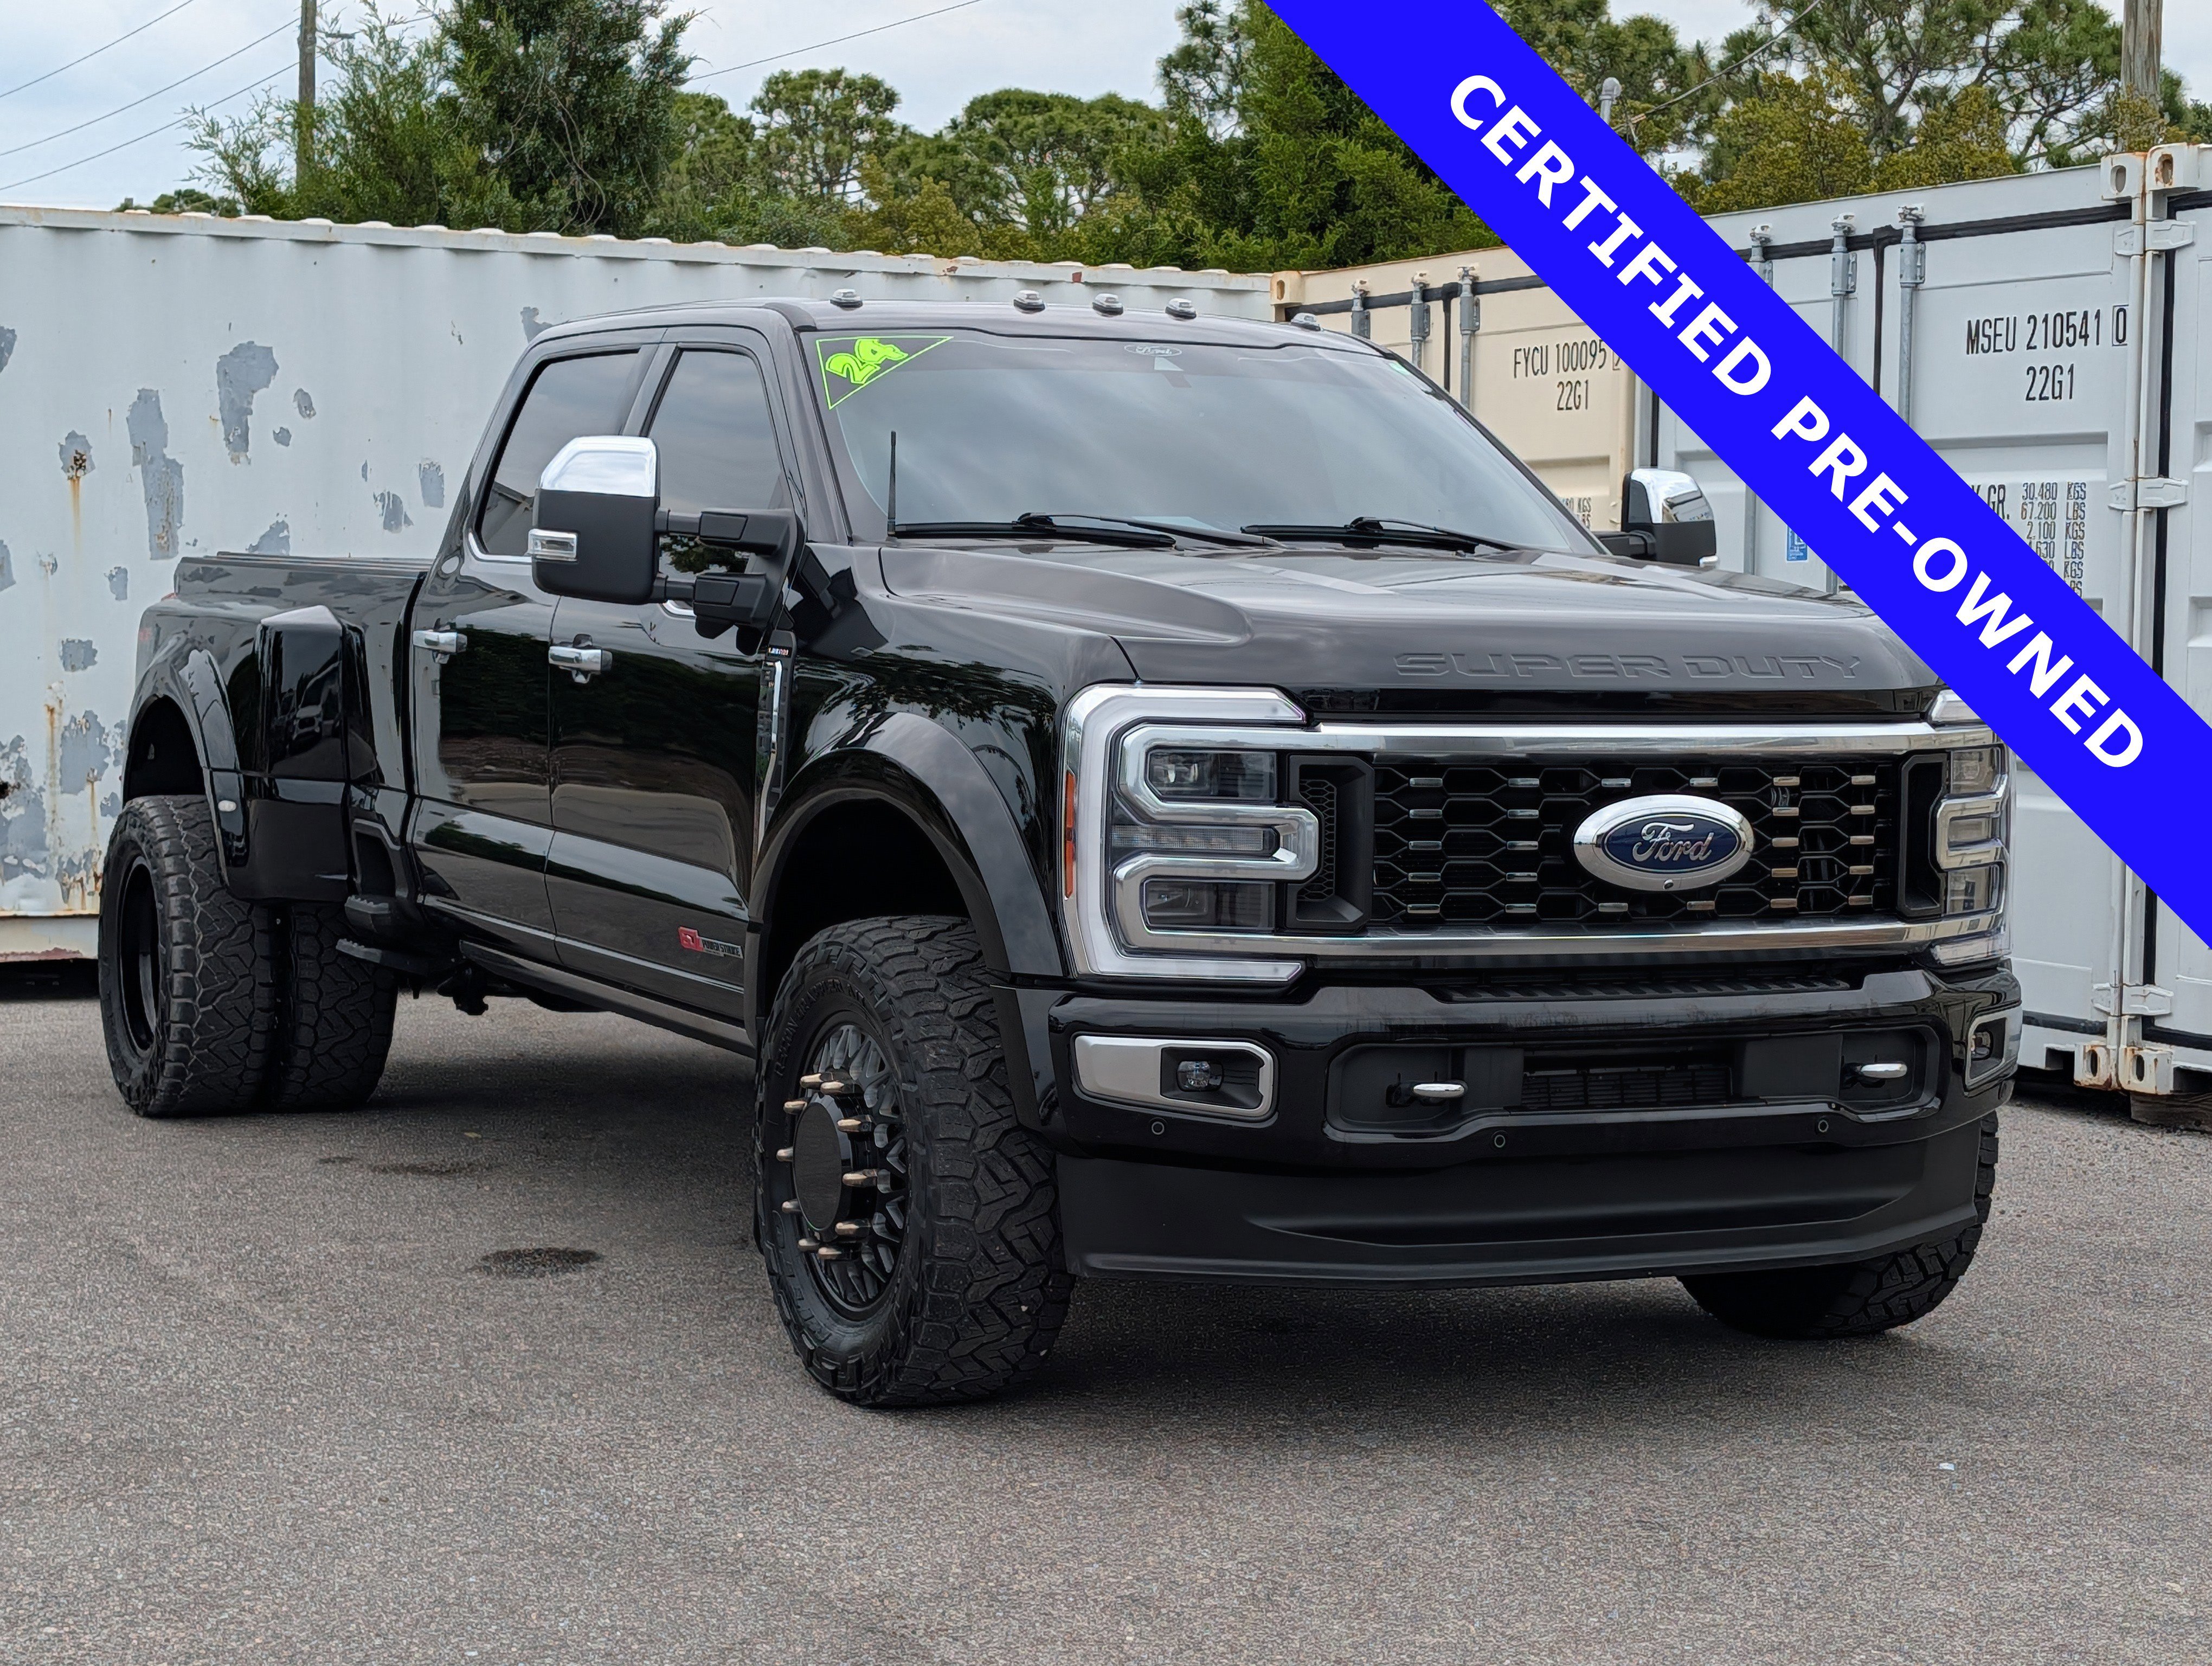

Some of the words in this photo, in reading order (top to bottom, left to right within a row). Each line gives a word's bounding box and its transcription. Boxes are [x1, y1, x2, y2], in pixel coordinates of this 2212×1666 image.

[1966, 316, 2017, 355] MSEU
[2026, 308, 2101, 351] 210541
[1514, 344, 1549, 379] FYCU
[1555, 339, 1607, 374] 100095
[2025, 363, 2075, 401] 22G1
[1557, 379, 1589, 411] 22G1
[2066, 481, 2087, 501] KGS
[2066, 502, 2086, 521] LBS
[2065, 521, 2086, 541] KGS
[2064, 541, 2085, 560] LBS
[2063, 561, 2084, 579] KGS
[2065, 580, 2083, 599] BS
[1394, 652, 1672, 679] SUPER
[1682, 655, 1862, 680] DUTY
[1632, 822, 1715, 862] Ford
